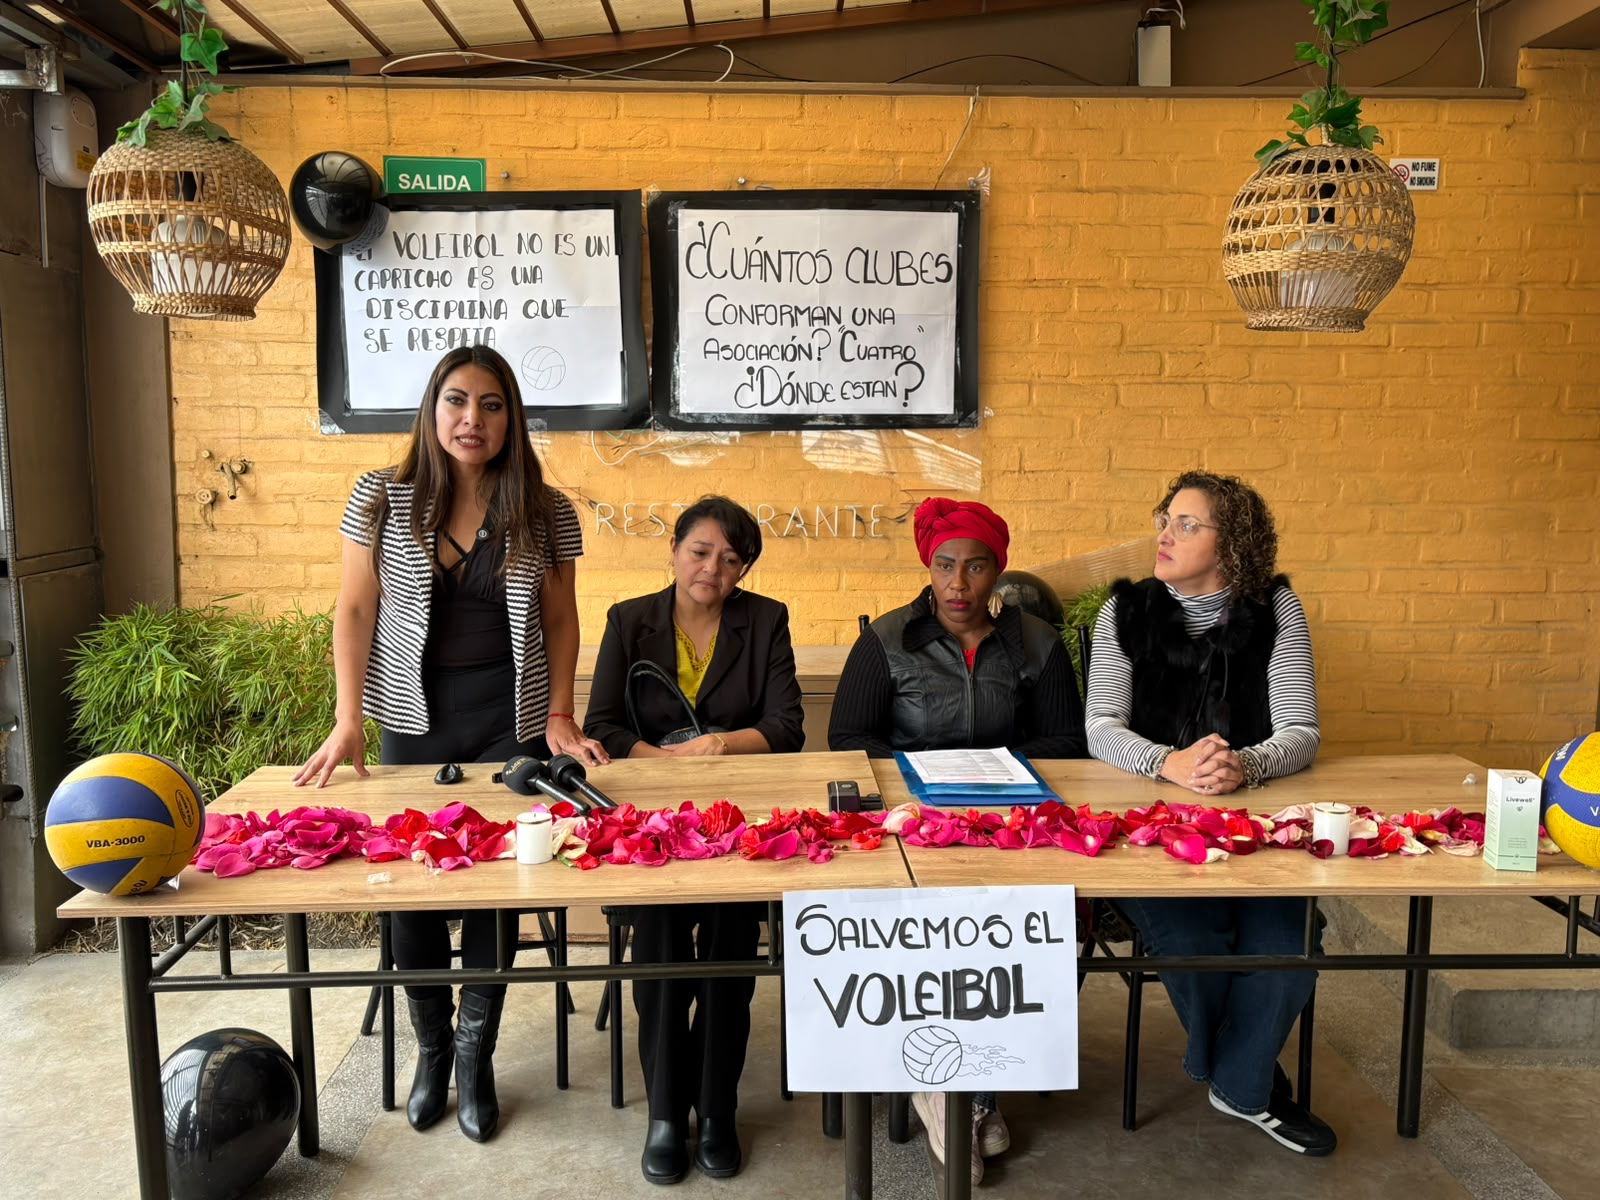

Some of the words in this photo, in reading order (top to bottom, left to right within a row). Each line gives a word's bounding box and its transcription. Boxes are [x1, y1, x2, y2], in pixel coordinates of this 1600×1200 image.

[1411, 162, 1419, 171] NO
[1421, 162, 1436, 171] FUME
[398, 173, 471, 191] SALIDA
[392, 231, 504, 260] VOLEIBOL
[517, 232, 543, 256] NO
[554, 233, 577, 256] ES
[585, 234, 611, 258] UN
[685, 220, 833, 285] ¿CUÁNTOS
[845, 246, 953, 287] CLUBES
[354, 266, 453, 292] CAPRICHO
[467, 265, 495, 290] ES
[511, 265, 543, 286] UNA
[365, 299, 508, 321] DISCIPLINA
[522, 298, 570, 320] QUE
[705, 293, 842, 328] CONFORMAN
[851, 307, 896, 326] UNA
[363, 327, 393, 354] SE
[407, 326, 496, 352] RESPETA
[703, 328, 832, 363] ASOCIACIÓN?
[596, 502, 885, 537] RESRANTE
[86, 835, 145, 849] VBA-3000
[795, 903, 1013, 956] SALVEMOS
[1024, 910, 1065, 944] EL
[813, 963, 1044, 1029] VOLEIBOL
